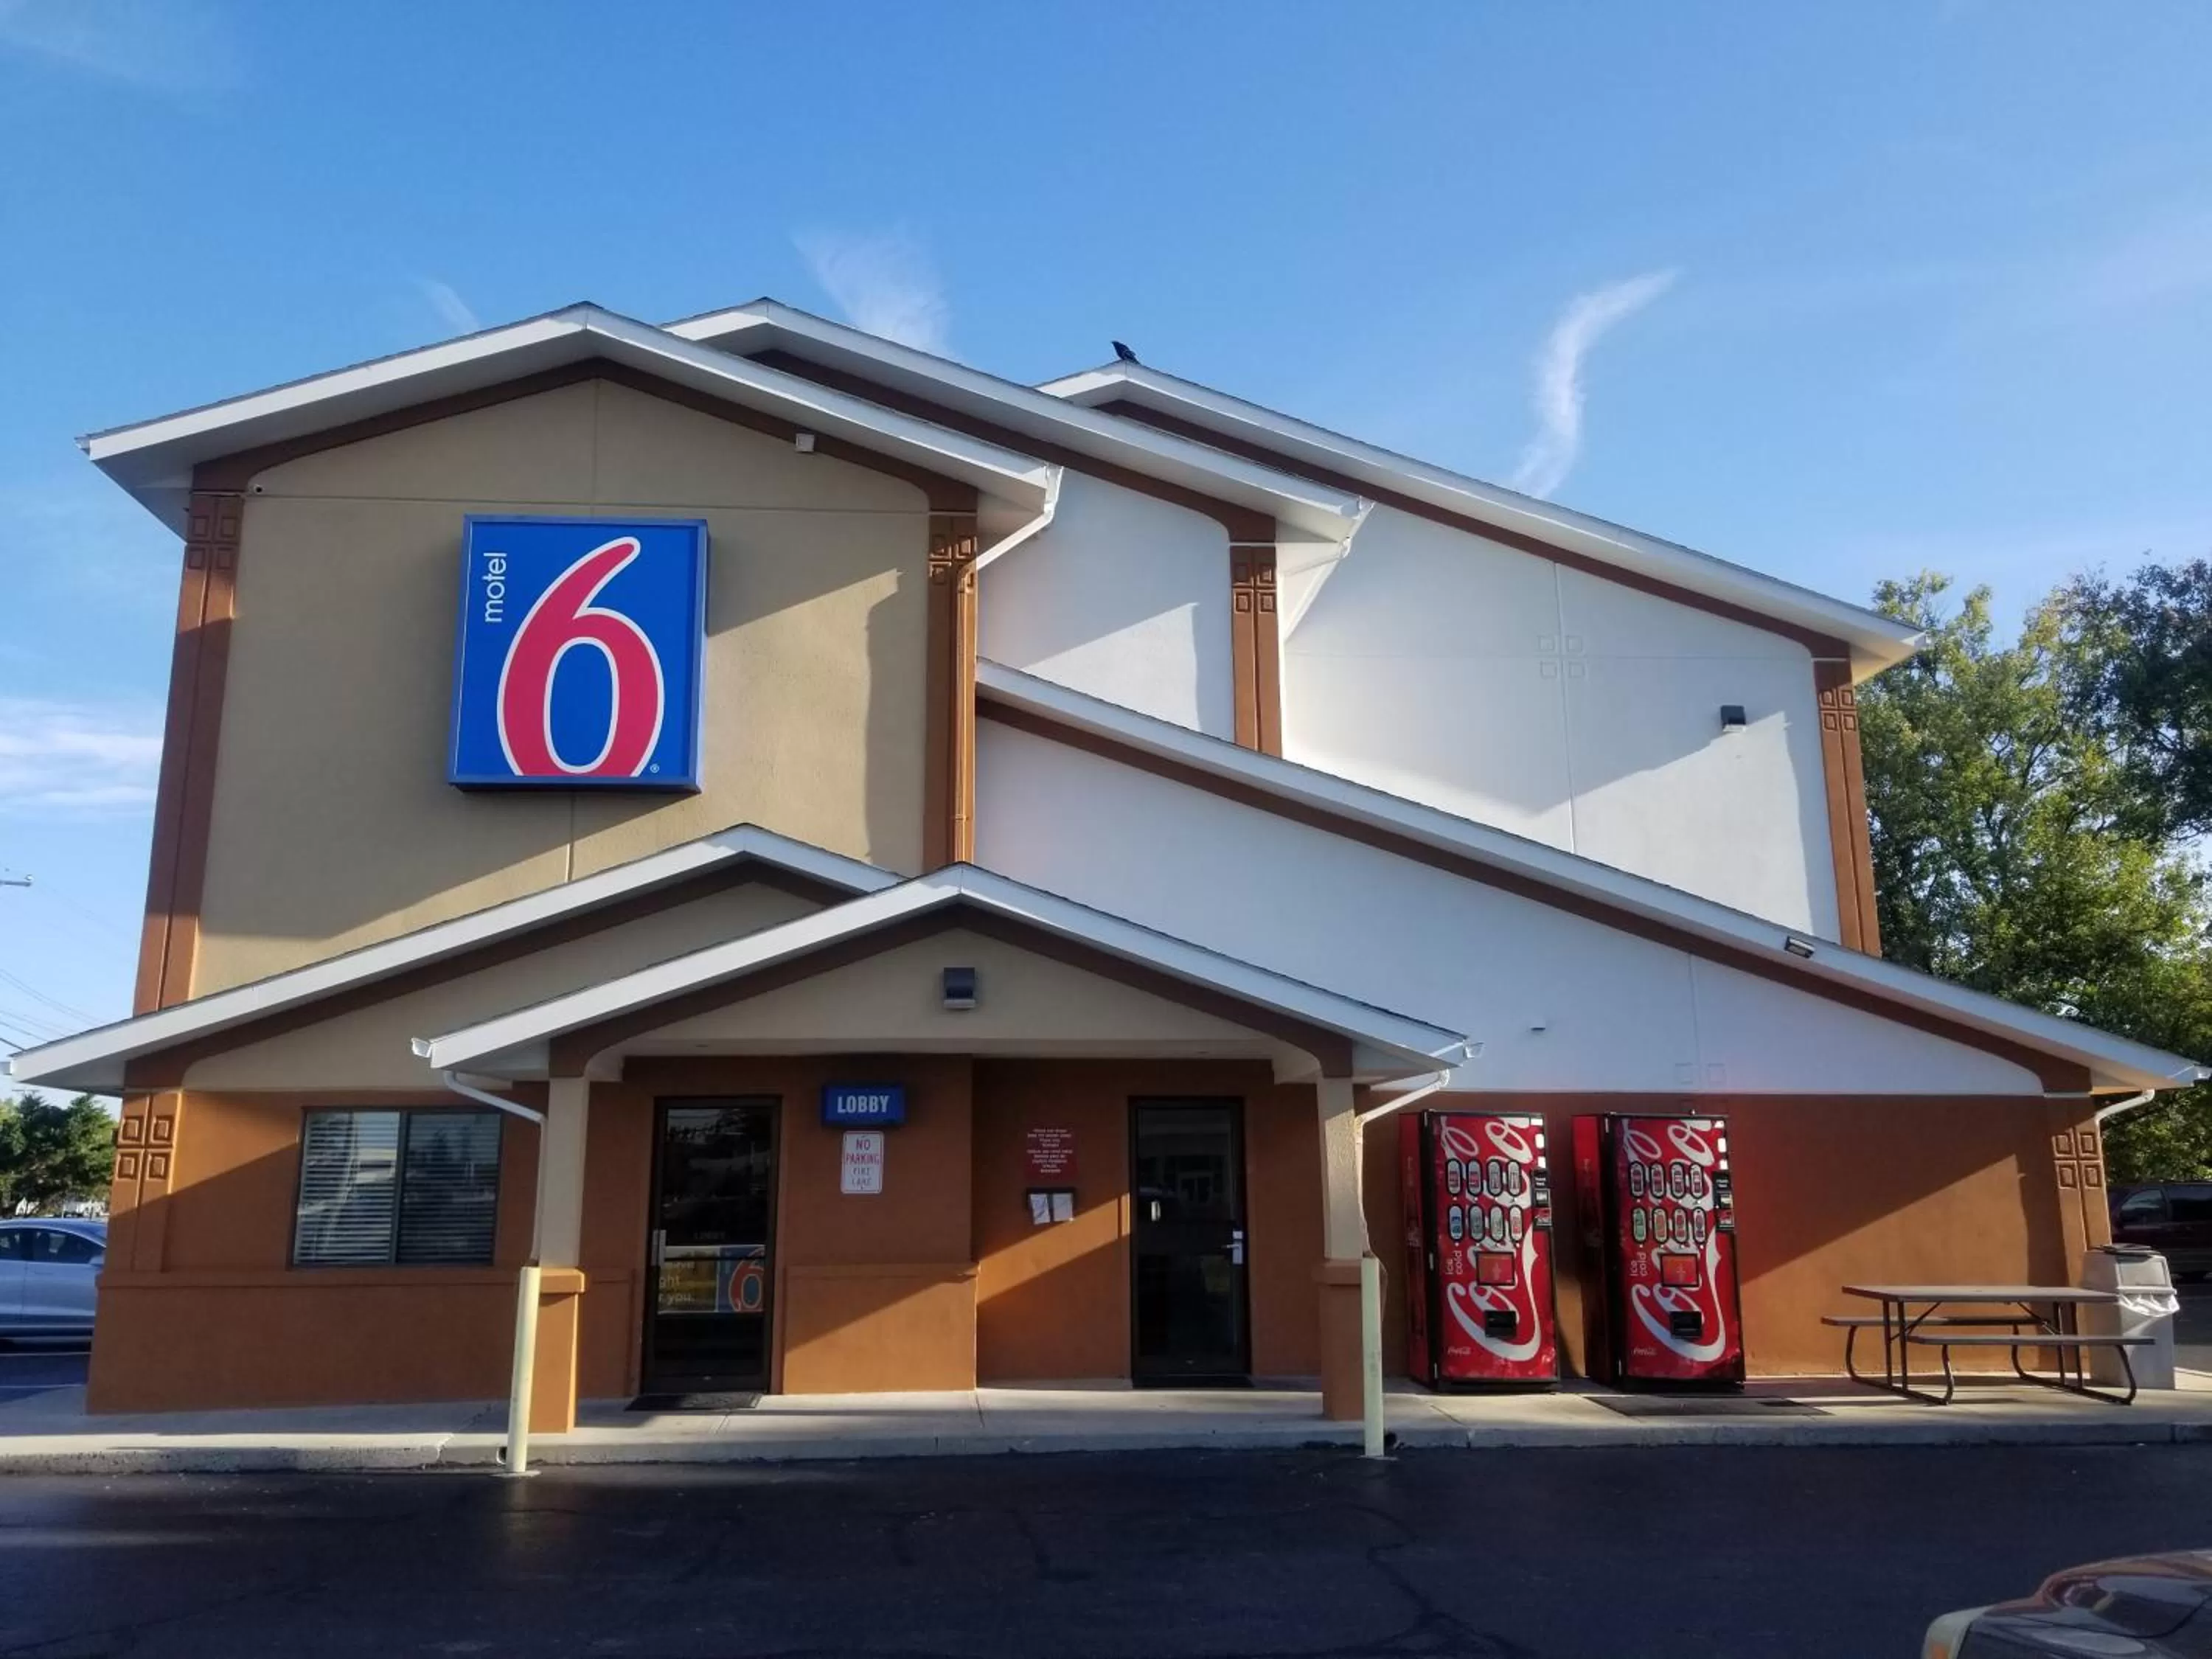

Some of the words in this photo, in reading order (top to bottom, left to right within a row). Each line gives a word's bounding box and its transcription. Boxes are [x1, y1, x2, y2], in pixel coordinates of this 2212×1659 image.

[482, 552, 507, 622] motel
[497, 536, 664, 777] 6
[837, 1095, 890, 1113] LOBBY
[855, 1138, 871, 1150] NO
[846, 1152, 880, 1165] PARKING
[1636, 1251, 1649, 1276] cold
